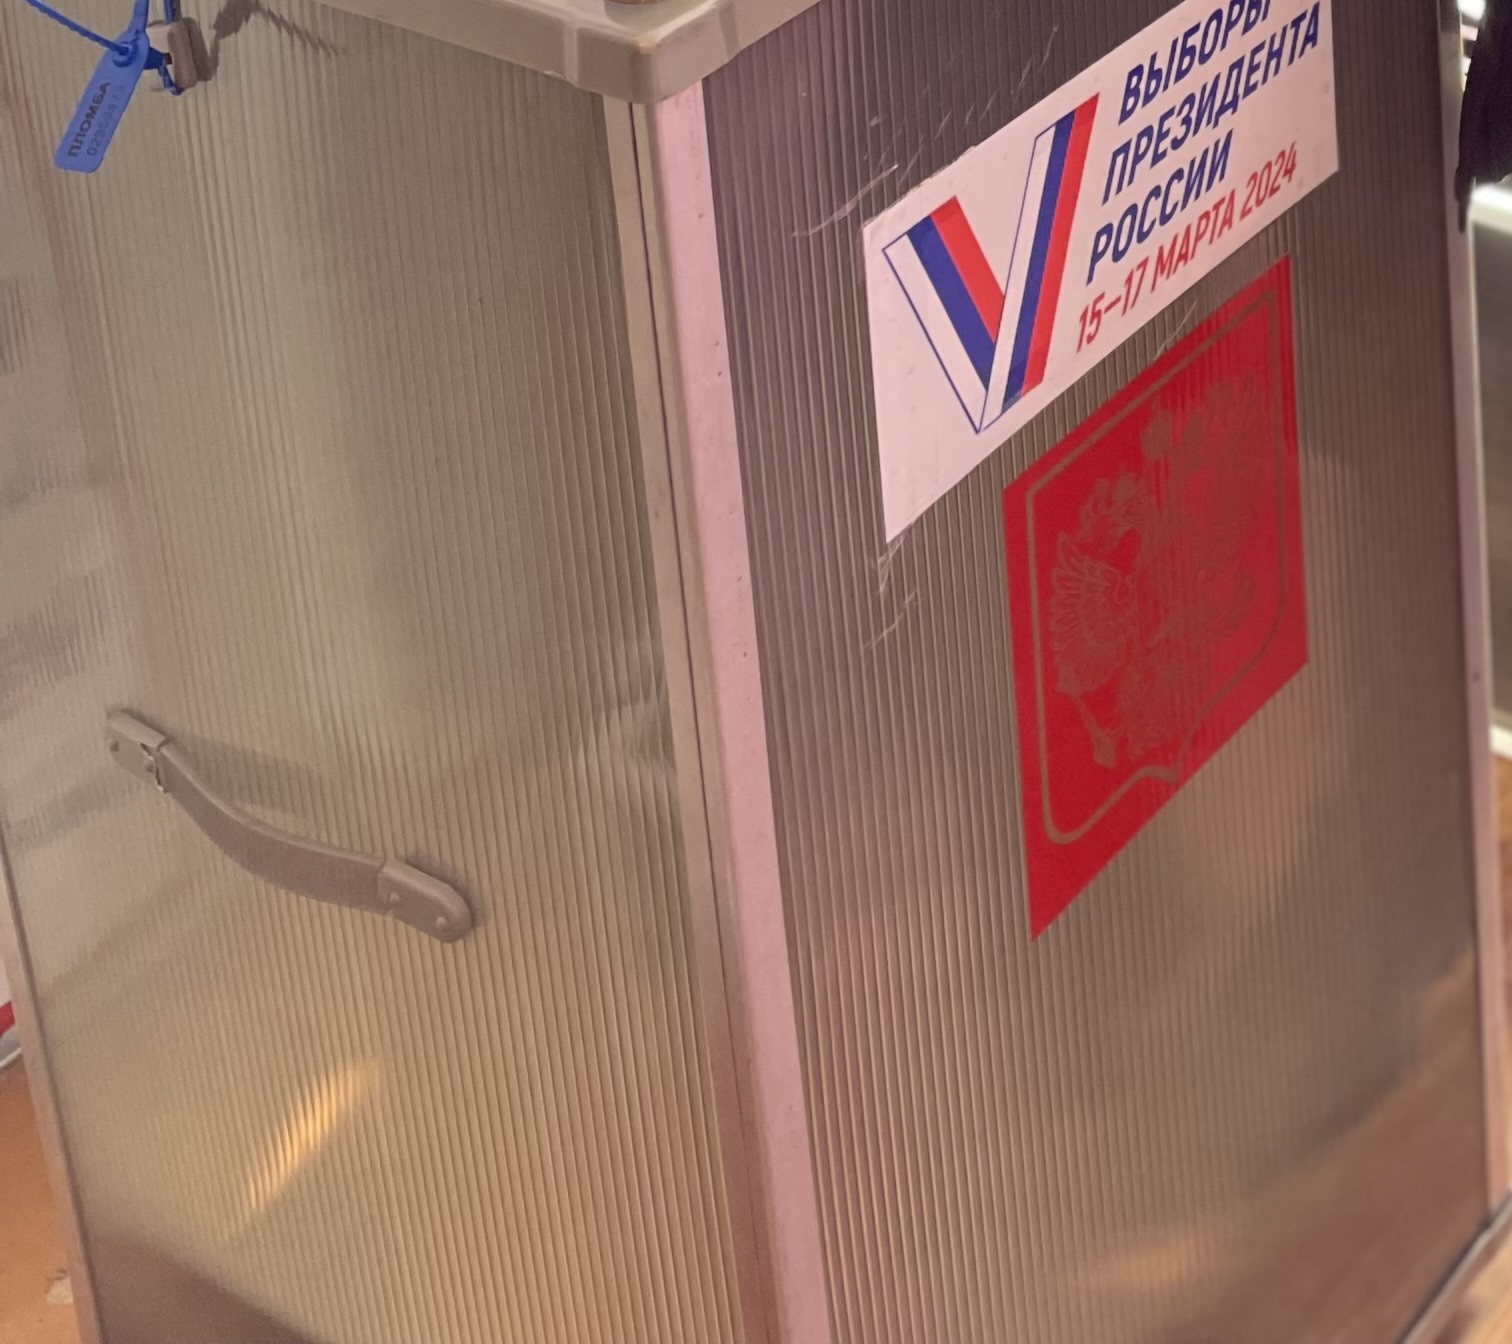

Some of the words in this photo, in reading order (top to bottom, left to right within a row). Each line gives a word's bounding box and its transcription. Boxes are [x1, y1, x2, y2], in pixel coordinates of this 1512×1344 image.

[67, 81, 111, 157] ПЛОМБА
[1102, 0, 1321, 207] ПРЕЗИДЕНТА
[1086, 128, 1233, 287] РОССИИ
[1150, 187, 1236, 294] МАРТА
[1240, 141, 1297, 222] 2024
